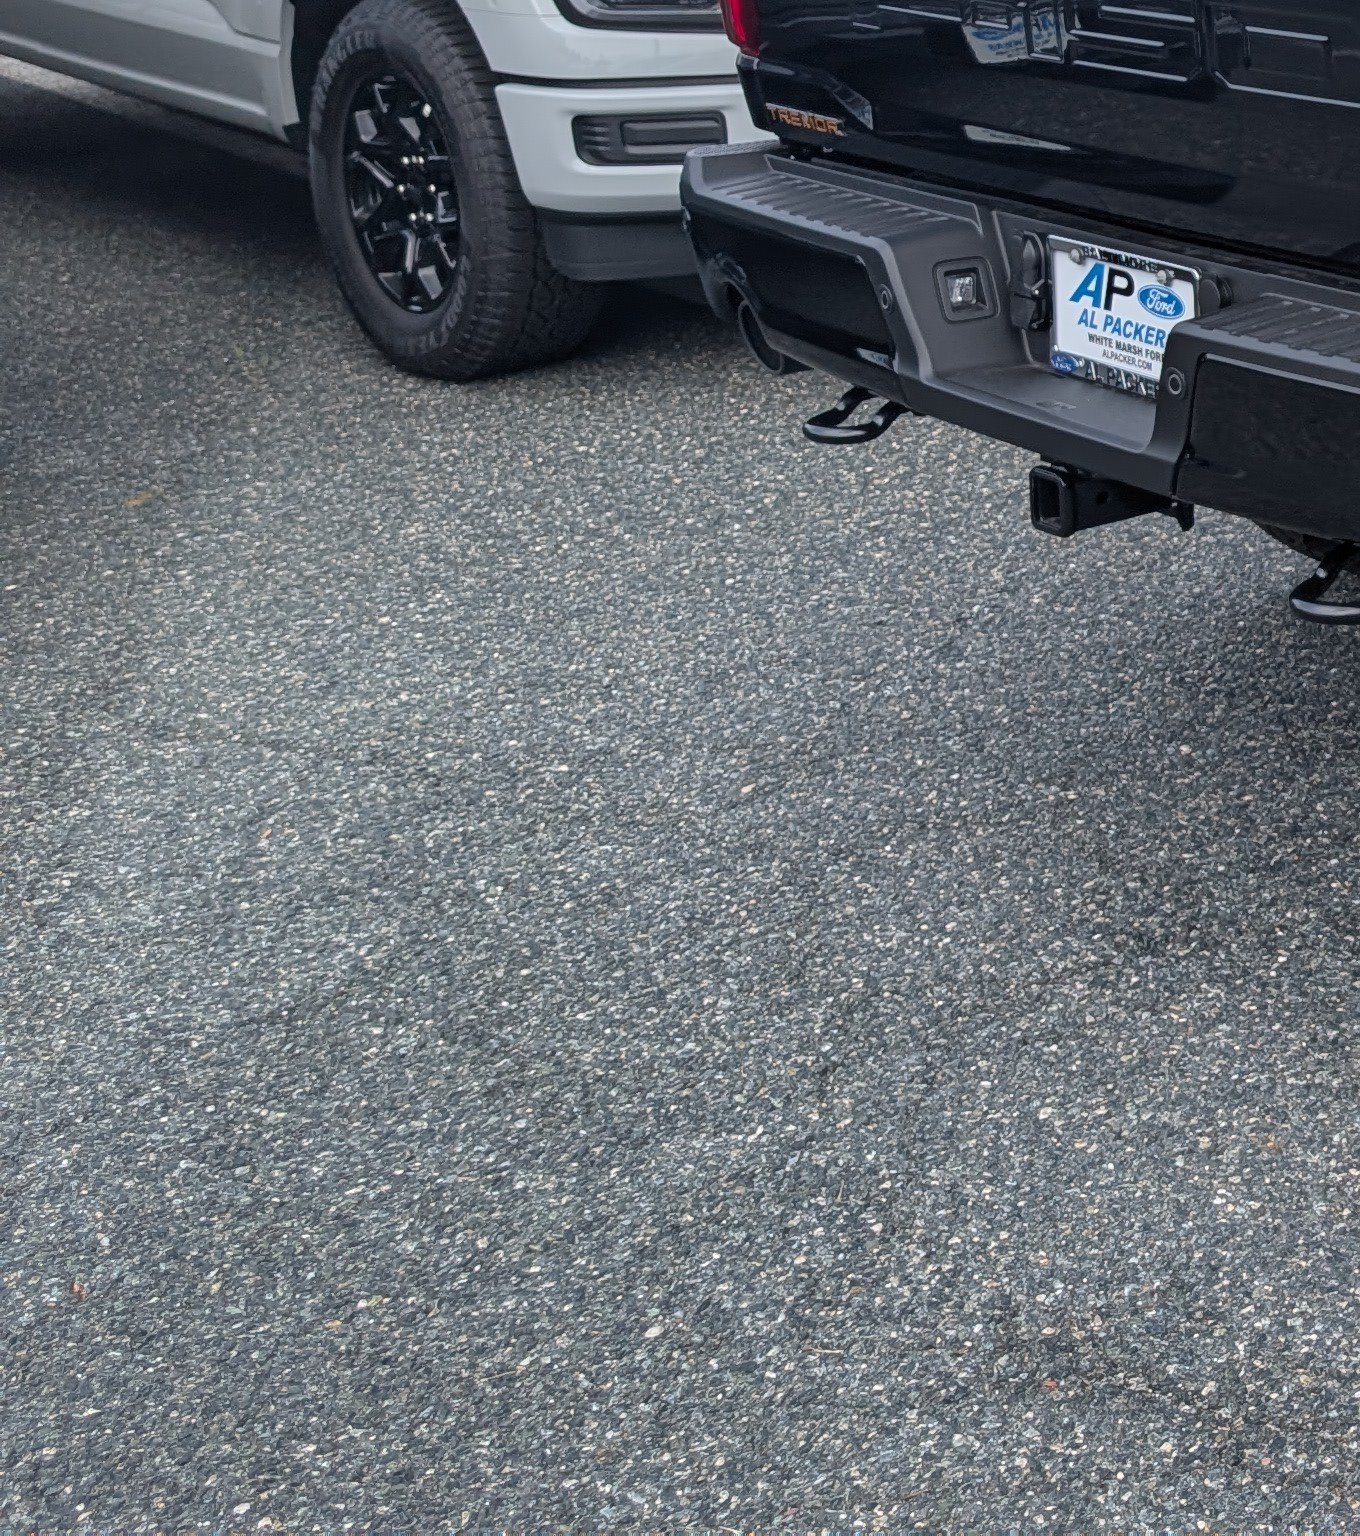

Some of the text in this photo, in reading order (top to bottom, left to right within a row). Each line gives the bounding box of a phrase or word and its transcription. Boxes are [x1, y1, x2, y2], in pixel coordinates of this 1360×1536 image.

[765, 102, 846, 137] TREMOR
[1069, 262, 1135, 312] AP
[1146, 288, 1176, 316] Ford
[1077, 308, 1167, 349] AL PACKER
[1087, 332, 1114, 349] WHITE
[1115, 340, 1143, 357] MARSH
[1102, 349, 1153, 371] ALPACKER.COM
